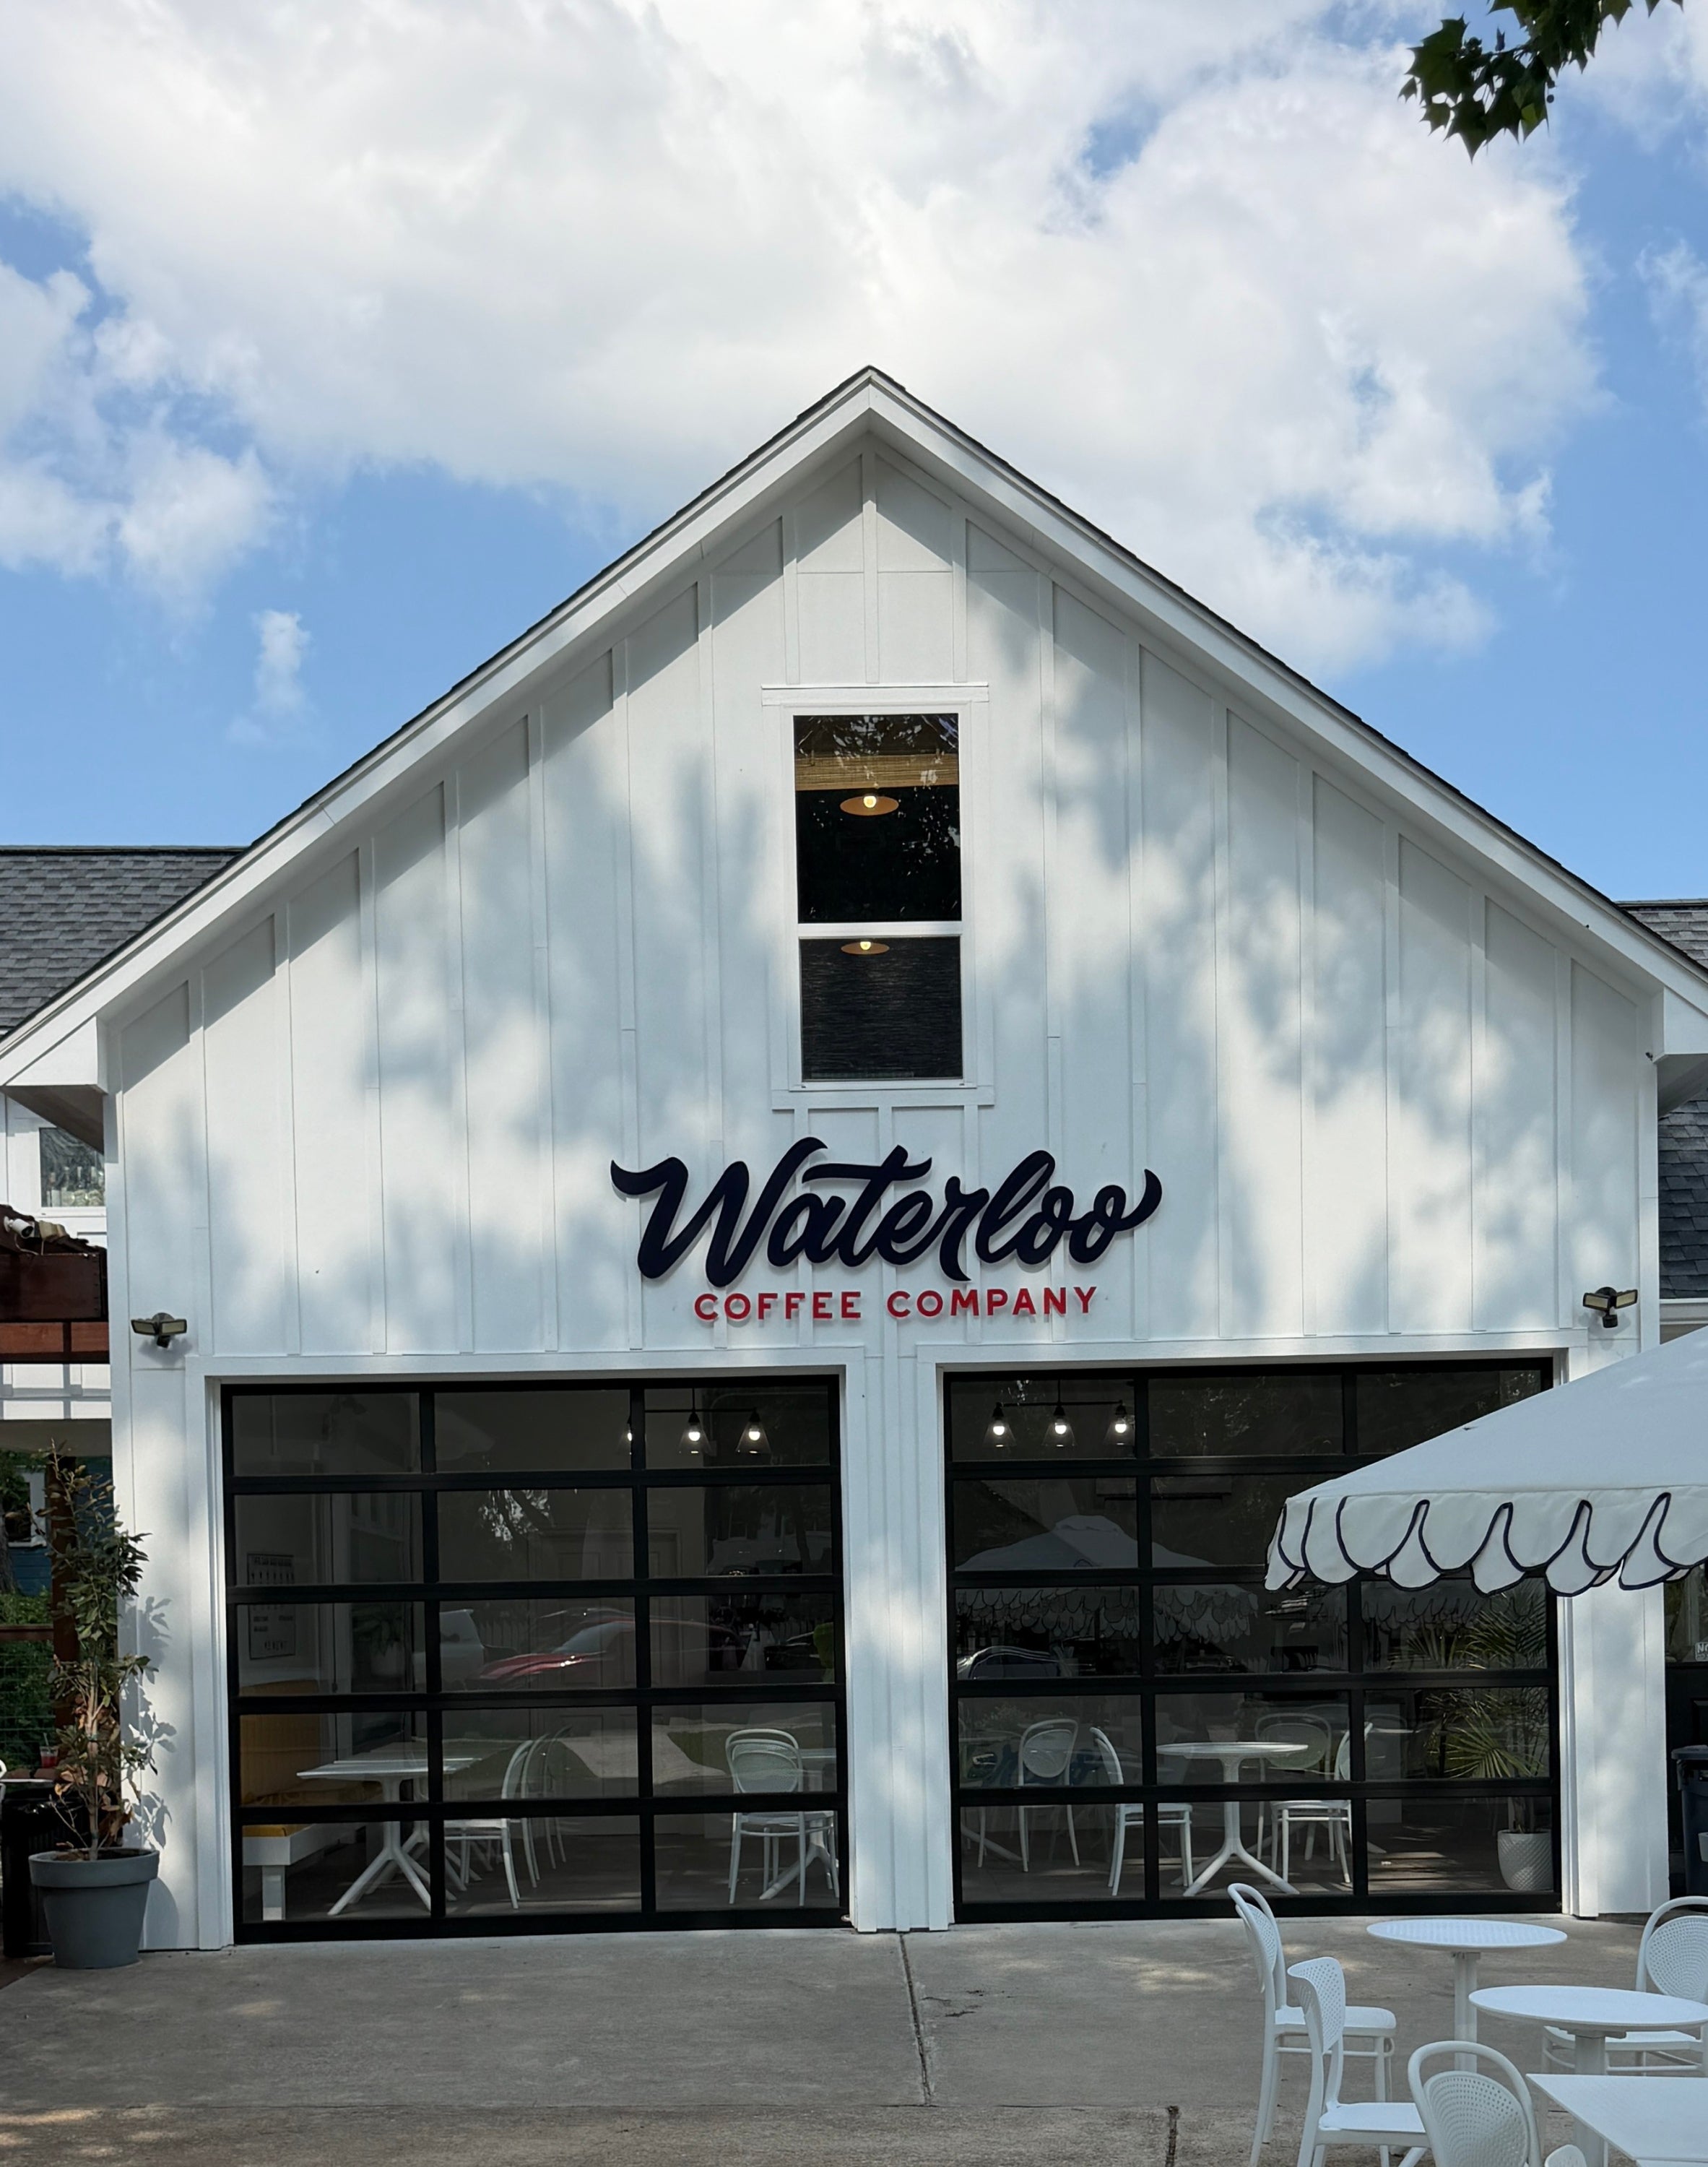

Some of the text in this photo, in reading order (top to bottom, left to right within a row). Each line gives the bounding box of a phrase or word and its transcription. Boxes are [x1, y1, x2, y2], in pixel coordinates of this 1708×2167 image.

[611, 1136, 1163, 1288] Waterloo
[694, 1286, 1096, 1320] COFFEE COMPANY
